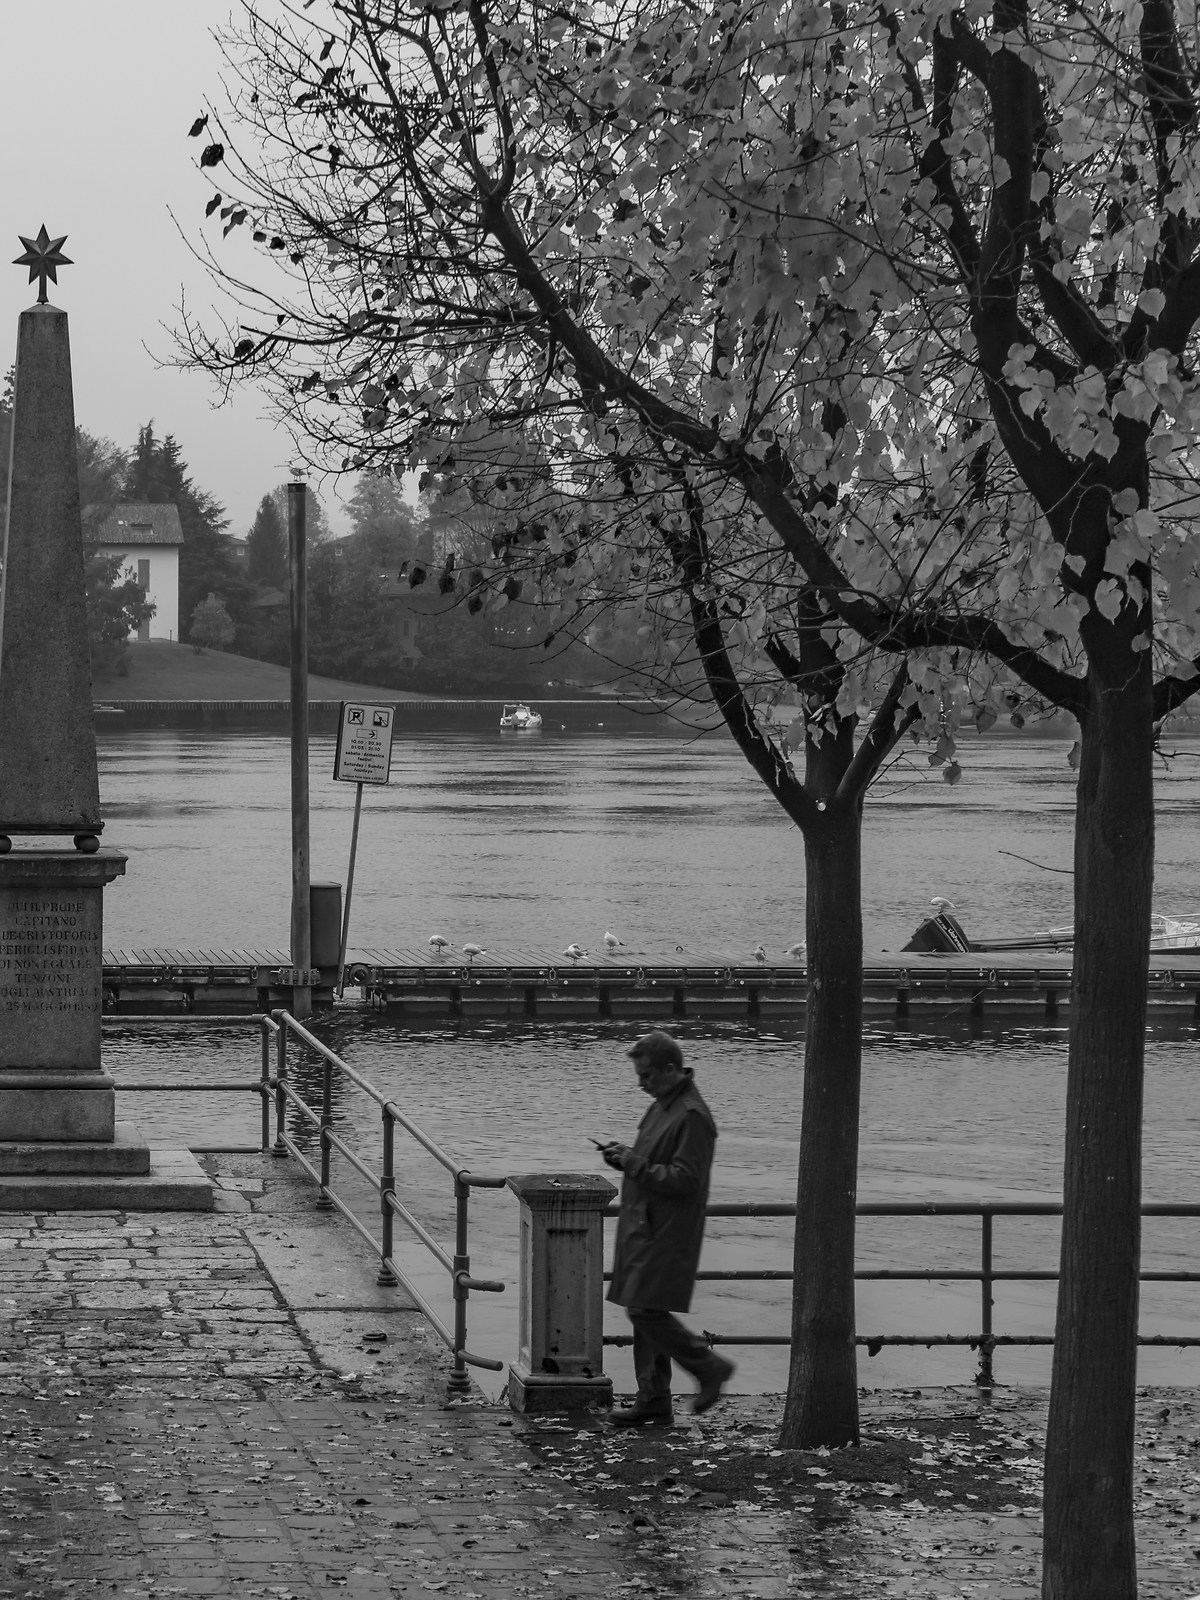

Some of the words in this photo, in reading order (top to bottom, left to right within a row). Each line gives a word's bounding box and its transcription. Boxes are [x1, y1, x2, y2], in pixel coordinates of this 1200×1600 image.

[31, 903, 41, 912] IL
[43, 903, 84, 912] PRODE
[15, 917, 77, 926] CAPITANO
[14, 960, 40, 969] NON
[6, 1002, 20, 1011] 25
